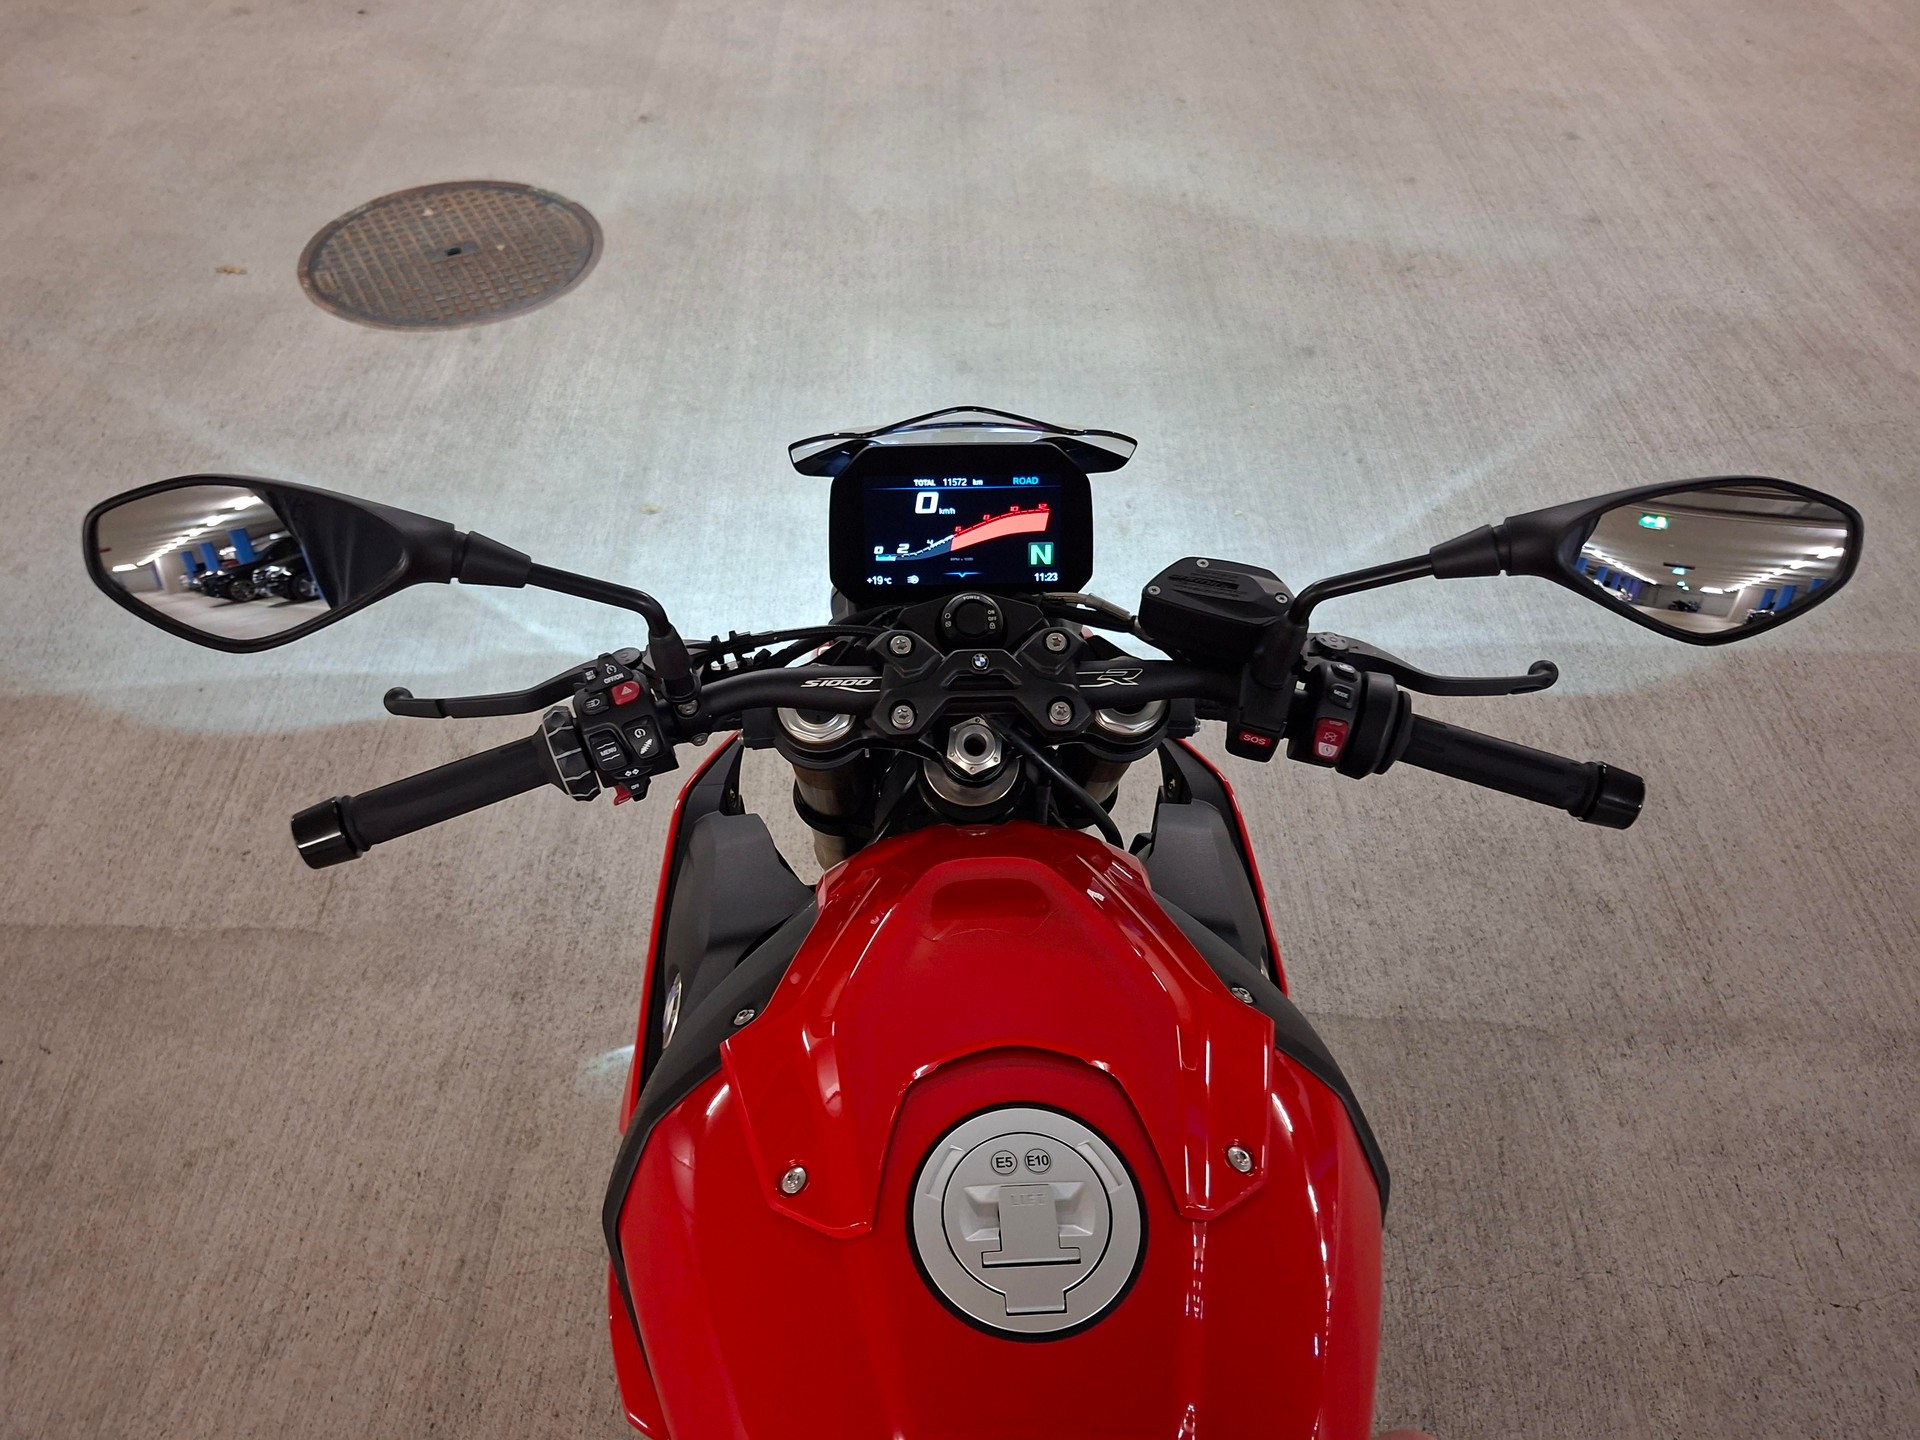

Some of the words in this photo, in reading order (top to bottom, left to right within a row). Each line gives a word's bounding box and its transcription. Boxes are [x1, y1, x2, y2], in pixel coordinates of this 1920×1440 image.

[943, 478, 967, 486] 11572
[1012, 477, 1039, 485] ROAD
[915, 491, 939, 514] 0
[874, 546, 884, 554] 0
[897, 543, 910, 554] 2
[1030, 544, 1052, 565] N
[1034, 573, 1058, 582] 11:23
[1097, 668, 1143, 685] R
[801, 679, 874, 688] S1000
[1242, 734, 1266, 746] SOS
[995, 1156, 1013, 1168] E5
[1027, 1154, 1049, 1167] E10
